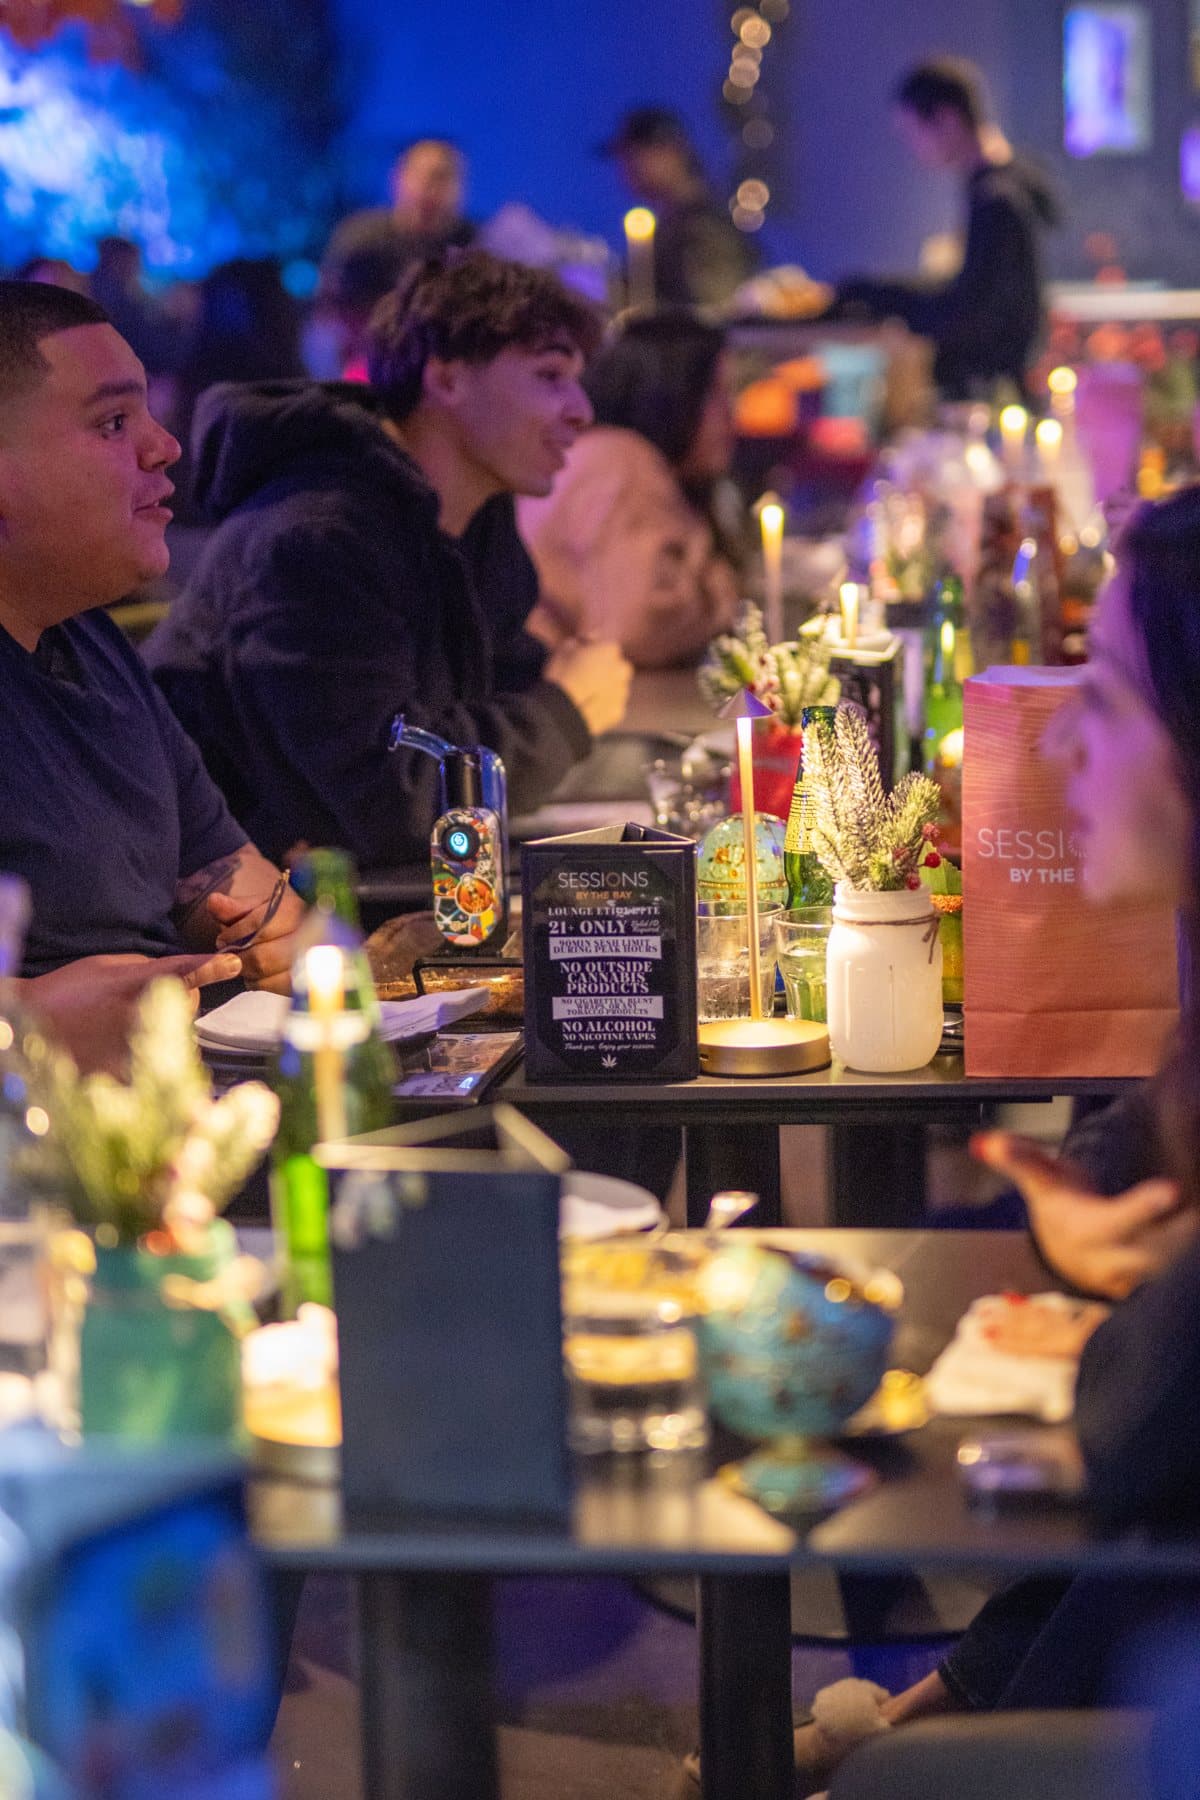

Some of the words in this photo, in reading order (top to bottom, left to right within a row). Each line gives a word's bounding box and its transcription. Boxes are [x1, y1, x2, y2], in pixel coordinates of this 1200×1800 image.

[558, 871, 649, 888] SESSIONS
[1010, 868, 1032, 882] BY
[1037, 868, 1075, 882] THE
[575, 890, 589, 900] BY
[591, 890, 609, 900] THE
[612, 890, 632, 900] BAY
[548, 906, 594, 916] LOUNGE
[549, 920, 575, 934] 21+
[579, 920, 627, 934] ONLY
[559, 939, 591, 947] 90MIN
[553, 945, 592, 953] DURING
[595, 945, 620, 953] PEAK
[623, 945, 658, 953] HOURS
[560, 961, 582, 973] NO
[585, 960, 652, 972] OUTSIDE
[567, 972, 647, 983] CANNABIS
[567, 982, 649, 994] PRODUCTS
[562, 1021, 583, 1032] NO
[586, 1020, 656, 1032] ALCOHOL
[562, 1033, 576, 1041] NO
[625, 1032, 657, 1040] VAPES
